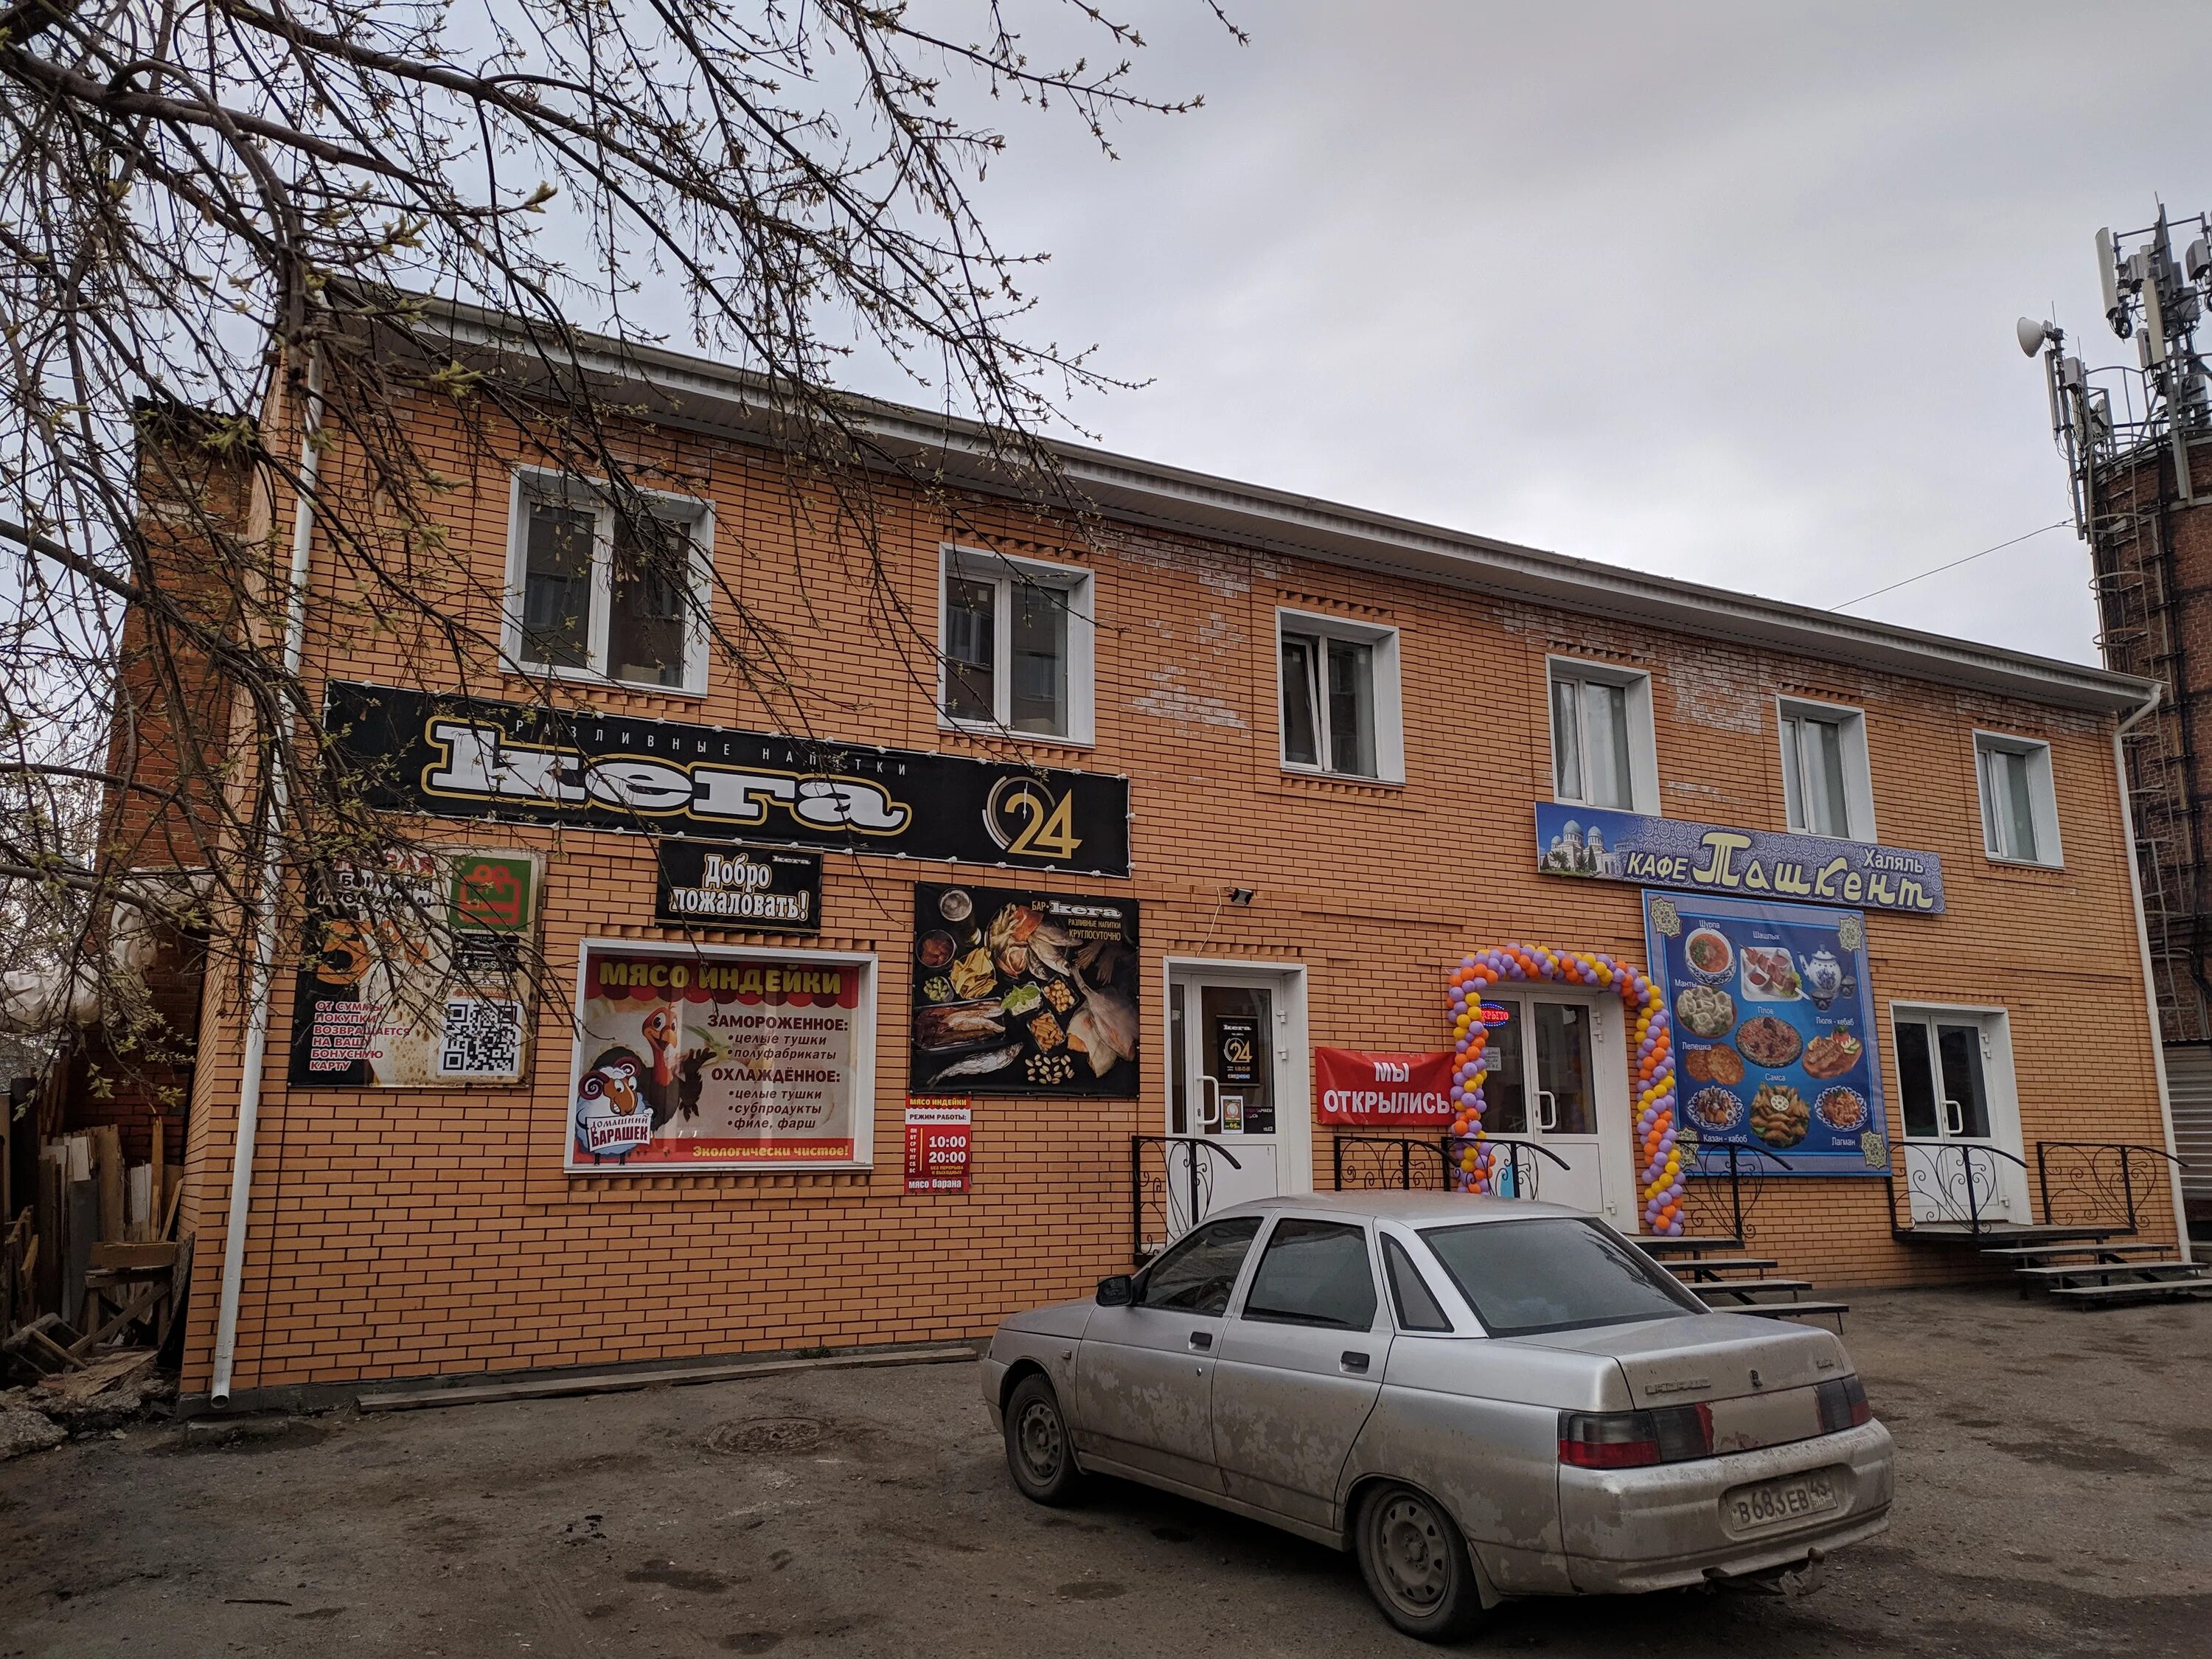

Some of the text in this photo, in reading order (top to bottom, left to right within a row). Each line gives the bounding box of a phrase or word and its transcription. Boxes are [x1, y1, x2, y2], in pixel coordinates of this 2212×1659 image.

[515, 720, 729, 756] РАЗЛИВНЫЕ
[1004, 787, 1083, 860] 24
[1863, 847, 1925, 874] Халяль
[703, 853, 771, 894] Добро
[1627, 831, 1933, 909] КАФЕ Ташкент
[670, 887, 809, 921] пожаловать!
[1032, 900, 1046, 911] БАР
[1068, 918, 1121, 929] РАЗЛИВНЫЕ НАПИТКИ
[1699, 919, 1721, 930] Шурпа
[1068, 929, 1121, 941] КРУГЛОСУТОЧНО
[1753, 931, 1781, 941] Шашлык
[599, 961, 842, 995] МЯСО ИНДЕЙКИ
[1674, 978, 1697, 988] Манты
[315, 1001, 333, 1011] ОТ
[1757, 1006, 1774, 1015] Плов
[314, 1013, 378, 1023] ПОКУПКИ
[707, 1015, 849, 1032] ЗАМОРОЖЕННОЕ:
[312, 1037, 331, 1047] НА
[734, 1034, 827, 1047] целые тушки
[1682, 1041, 1712, 1051] Лепешка
[311, 1048, 383, 1060] БОНУСНУЮ
[734, 1048, 837, 1060] полуфабрикаты
[1229, 1040, 1253, 1063] 24
[310, 1060, 352, 1071] КАРТУ
[712, 1067, 841, 1084] ОХЛАЖДЁННОЕ:
[1374, 1062, 1410, 1082] МЫ
[1764, 1073, 1786, 1082] Самса
[734, 1090, 822, 1102] целые тушки
[734, 1102, 822, 1114] субпродукты
[932, 1098, 967, 1107] ИНДЕЙКИ
[734, 1117, 816, 1130] филе, фарш
[591, 1126, 648, 1147] БАРАШЕК
[928, 1135, 967, 1148] 10:00
[1703, 1133, 1723, 1143] Казан
[1728, 1134, 1747, 1144] кабоб
[692, 1145, 849, 1158] Экологически чистое!
[928, 1151, 967, 1164] 20:00
[908, 1178, 962, 1189] мясо барана
